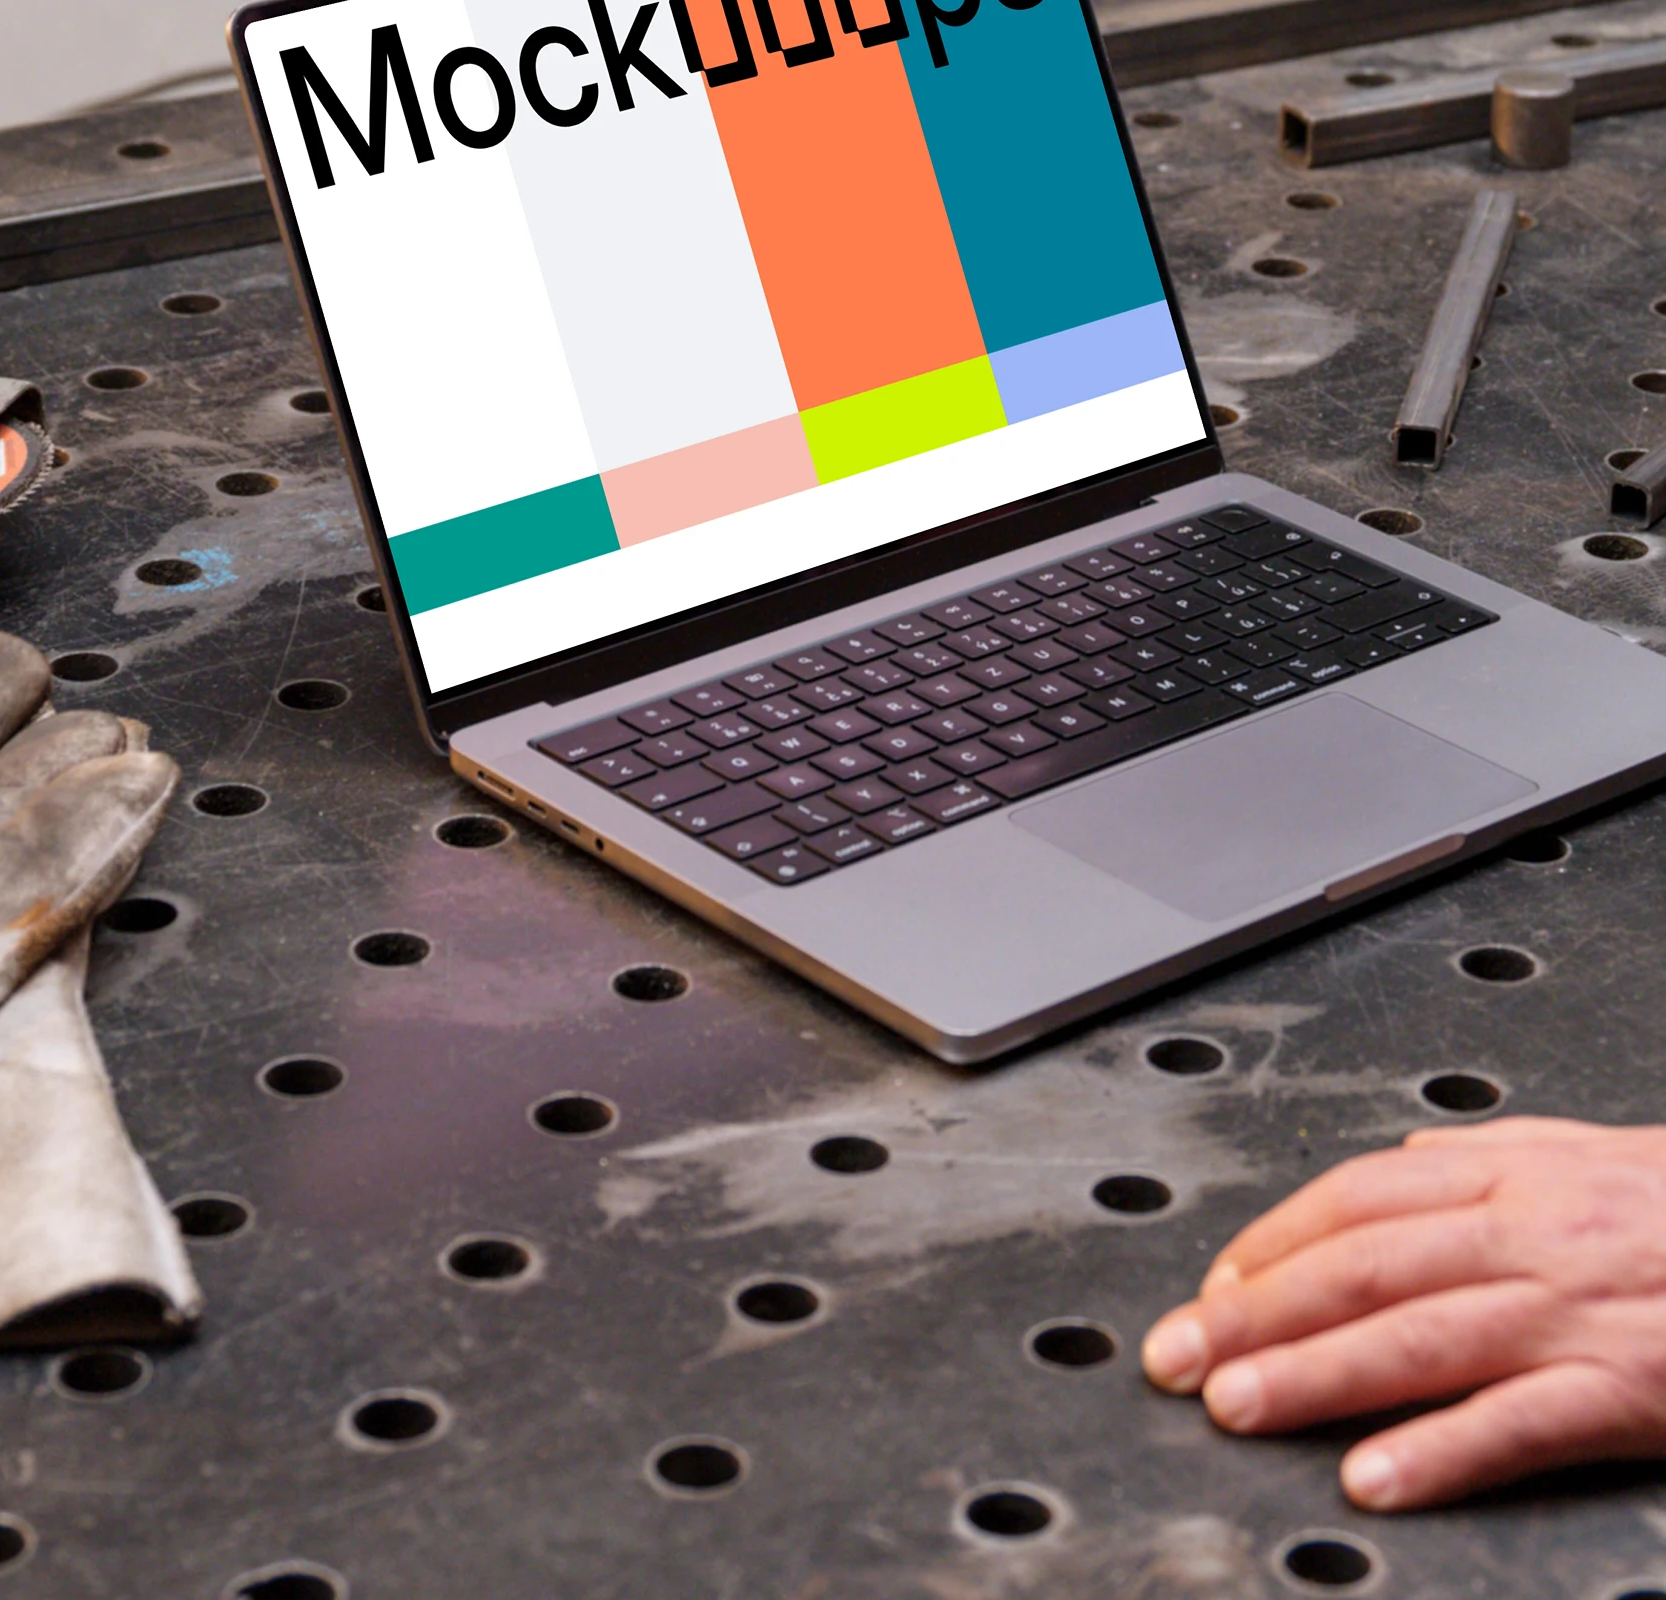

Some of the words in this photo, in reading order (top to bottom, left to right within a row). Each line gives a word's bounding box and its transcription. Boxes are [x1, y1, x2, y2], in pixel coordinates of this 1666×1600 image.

[1176, 599, 1188, 609] P
[1129, 615, 1145, 625] O
[1185, 633, 1201, 642] L
[1033, 649, 1050, 659] U
[1137, 649, 1154, 659] K
[985, 667, 1002, 677] Z
[1093, 667, 1105, 677] J
[1311, 664, 1341, 679] option
[935, 684, 950, 694] T
[1040, 684, 1058, 694] H
[1156, 679, 1175, 690] M
[1252, 680, 1297, 702] command
[886, 702, 903, 712] R
[992, 702, 1008, 712] G
[1108, 697, 1127, 708] N
[835, 720, 851, 730] E
[942, 720, 954, 730] F
[1060, 715, 1077, 725] B
[780, 737, 801, 749] W
[890, 738, 907, 748] D
[1009, 733, 1025, 743] V
[839, 756, 856, 767] S
[960, 752, 977, 762] C
[908, 770, 926, 781] X
[789, 776, 804, 786] A
[856, 789, 871, 799] Y
[941, 795, 991, 818] command
[891, 820, 925, 837] option
